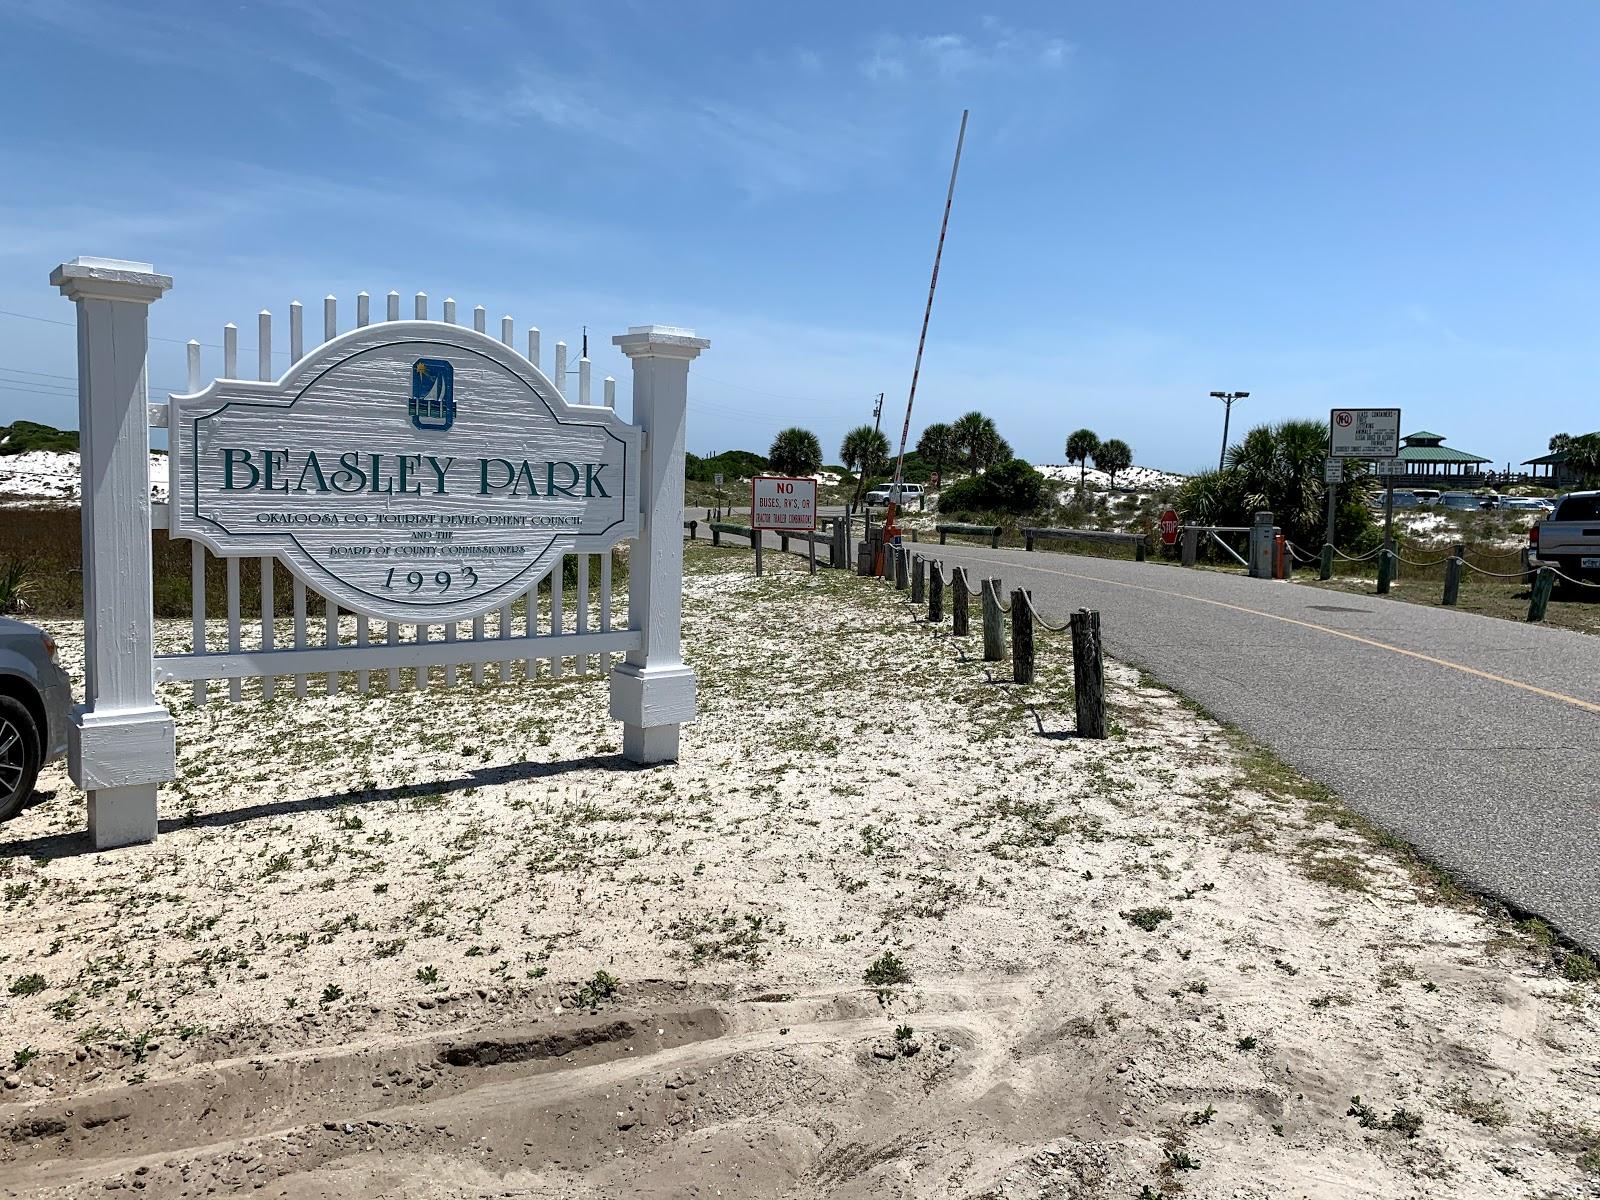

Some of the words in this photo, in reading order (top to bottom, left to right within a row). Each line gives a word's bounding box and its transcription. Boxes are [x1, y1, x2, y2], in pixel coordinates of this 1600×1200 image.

[219, 448, 457, 496] BEASLEY
[476, 457, 613, 499] PARK
[777, 482, 794, 494] NO
[760, 497, 781, 508] BUSES,
[802, 499, 810, 508] OR
[256, 512, 340, 524] OKALOOSA
[376, 513, 436, 525] TOURIST
[440, 514, 528, 526] DEVELOPMENT
[531, 516, 583, 527] COUNCIL
[1162, 520, 1177, 533] STOP
[411, 531, 432, 540] AND
[435, 531, 454, 540] THE
[329, 545, 372, 556] BOARD
[375, 545, 391, 556] OF
[394, 546, 437, 556] COUNTY
[441, 545, 526, 555] COMMISSIONERS
[380, 566, 479, 594] 1993
